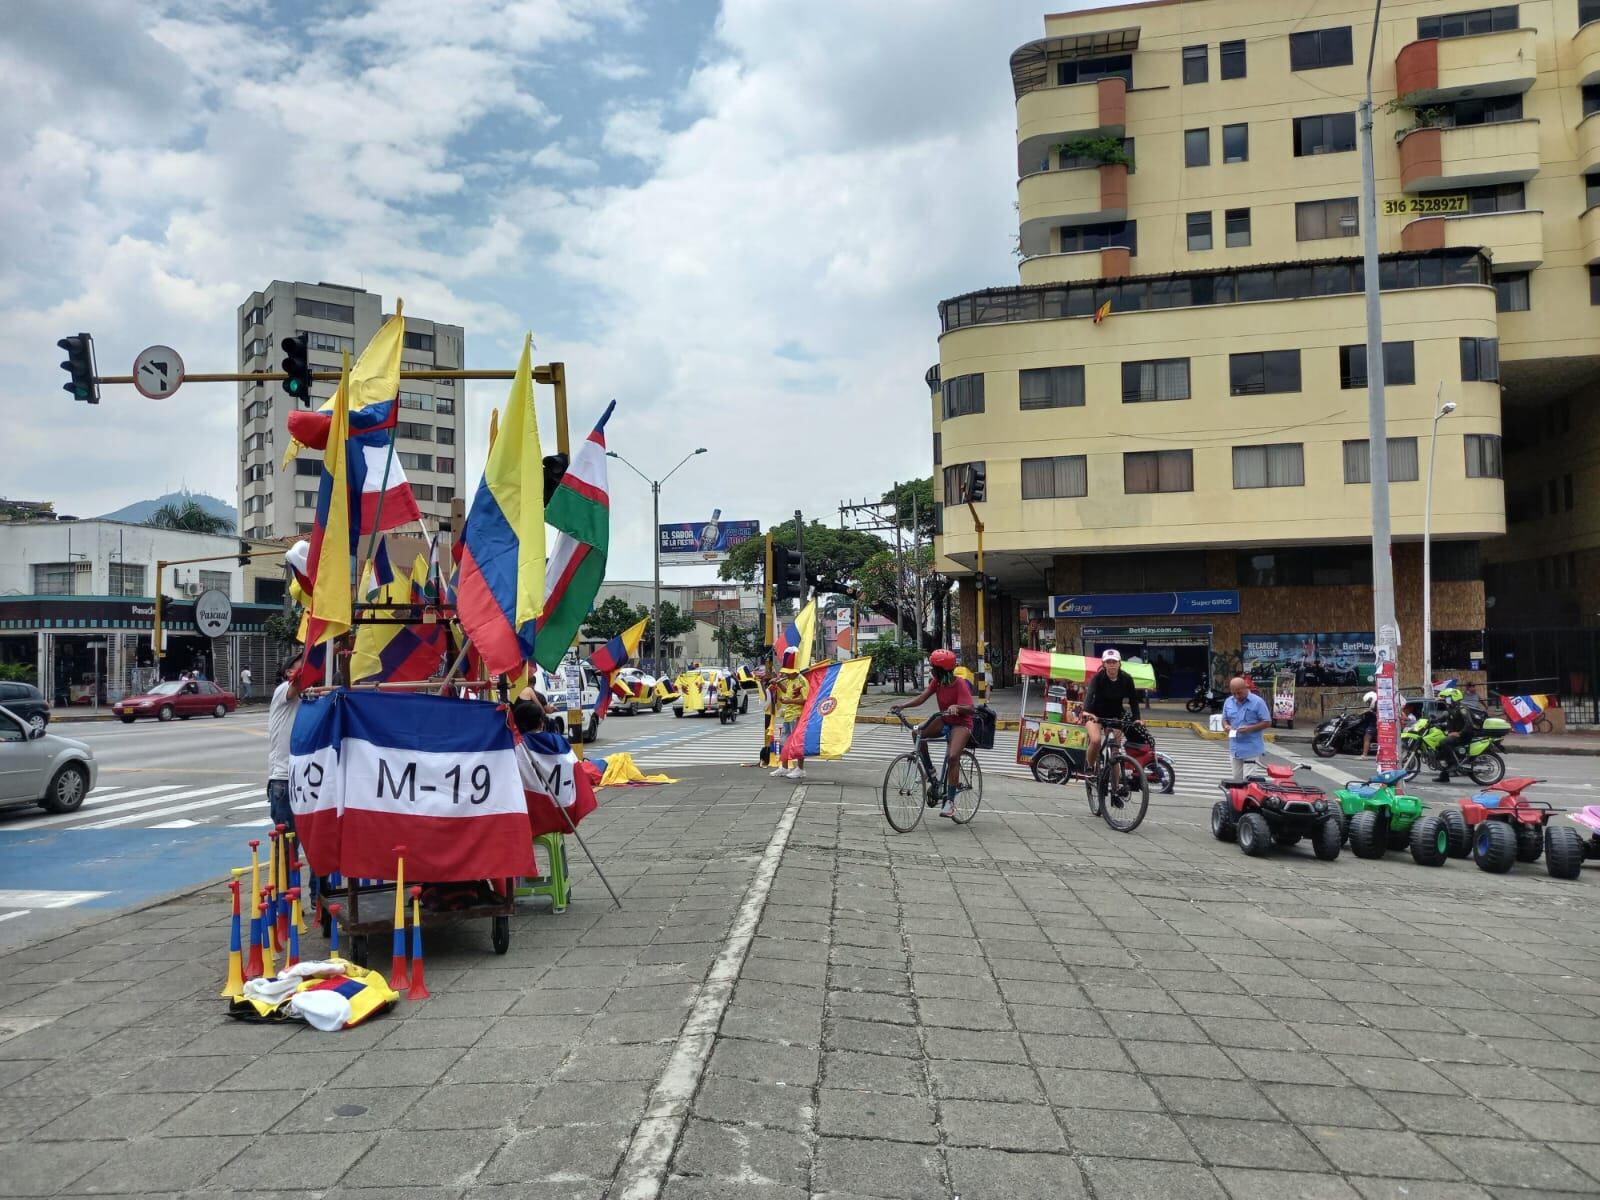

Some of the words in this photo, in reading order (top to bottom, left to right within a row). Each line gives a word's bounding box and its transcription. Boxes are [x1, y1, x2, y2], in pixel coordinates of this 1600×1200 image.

[1386, 200, 1406, 213] 316
[1410, 197, 1464, 212] 2528927
[662, 531, 670, 539] EL
[671, 530, 694, 539] SABOR
[200, 609, 229, 620] Pascual
[1248, 642, 1278, 650] RECARGUE
[1343, 642, 1374, 652] BetPlay
[376, 758, 491, 804] M-19
[531, 761, 574, 796] M-
